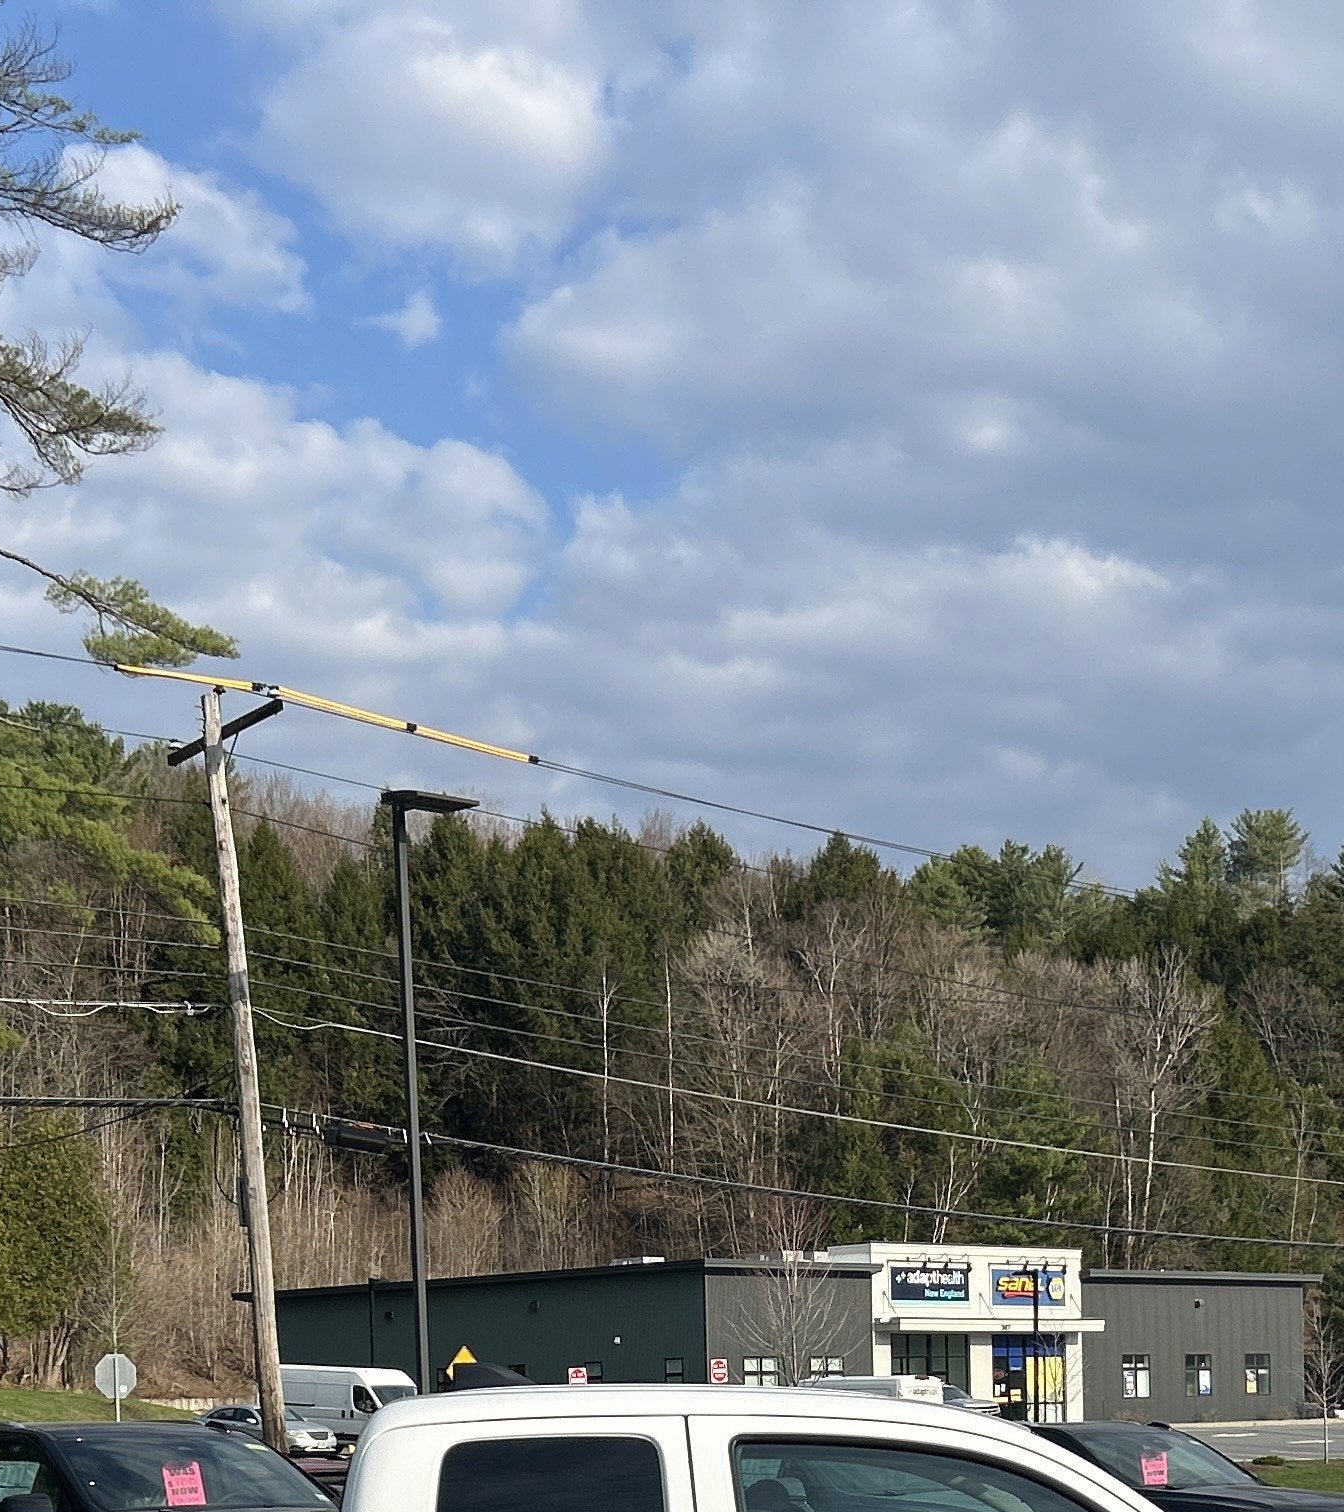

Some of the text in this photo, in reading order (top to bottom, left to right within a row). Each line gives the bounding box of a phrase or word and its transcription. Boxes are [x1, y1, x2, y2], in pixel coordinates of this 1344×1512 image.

[906, 1269, 965, 1287] adapthealth
[924, 1288, 965, 1299] New England
